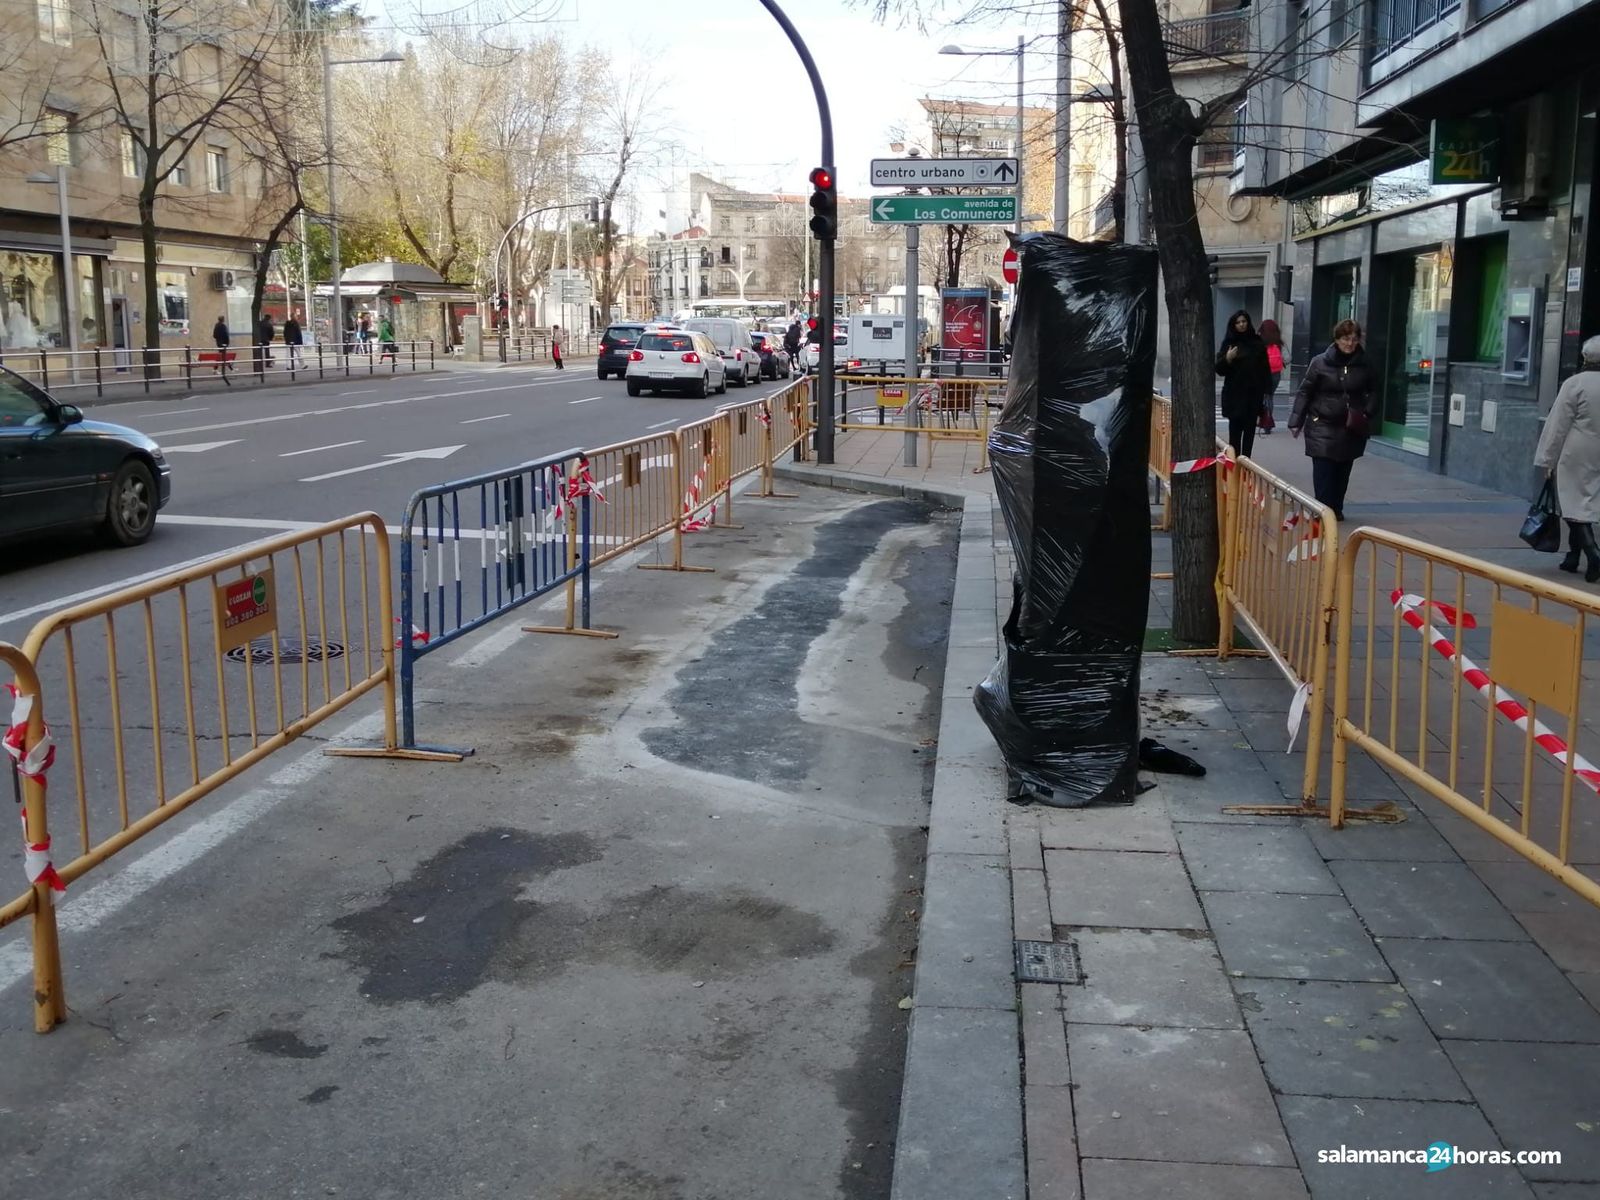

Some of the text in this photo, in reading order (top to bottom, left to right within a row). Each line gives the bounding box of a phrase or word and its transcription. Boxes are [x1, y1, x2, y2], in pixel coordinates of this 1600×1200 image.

[1440, 149, 1490, 180] 24h
[875, 167, 965, 178] centro urbano
[964, 199, 1013, 208] avenida de
[914, 208, 1013, 220] Los Comuneros
